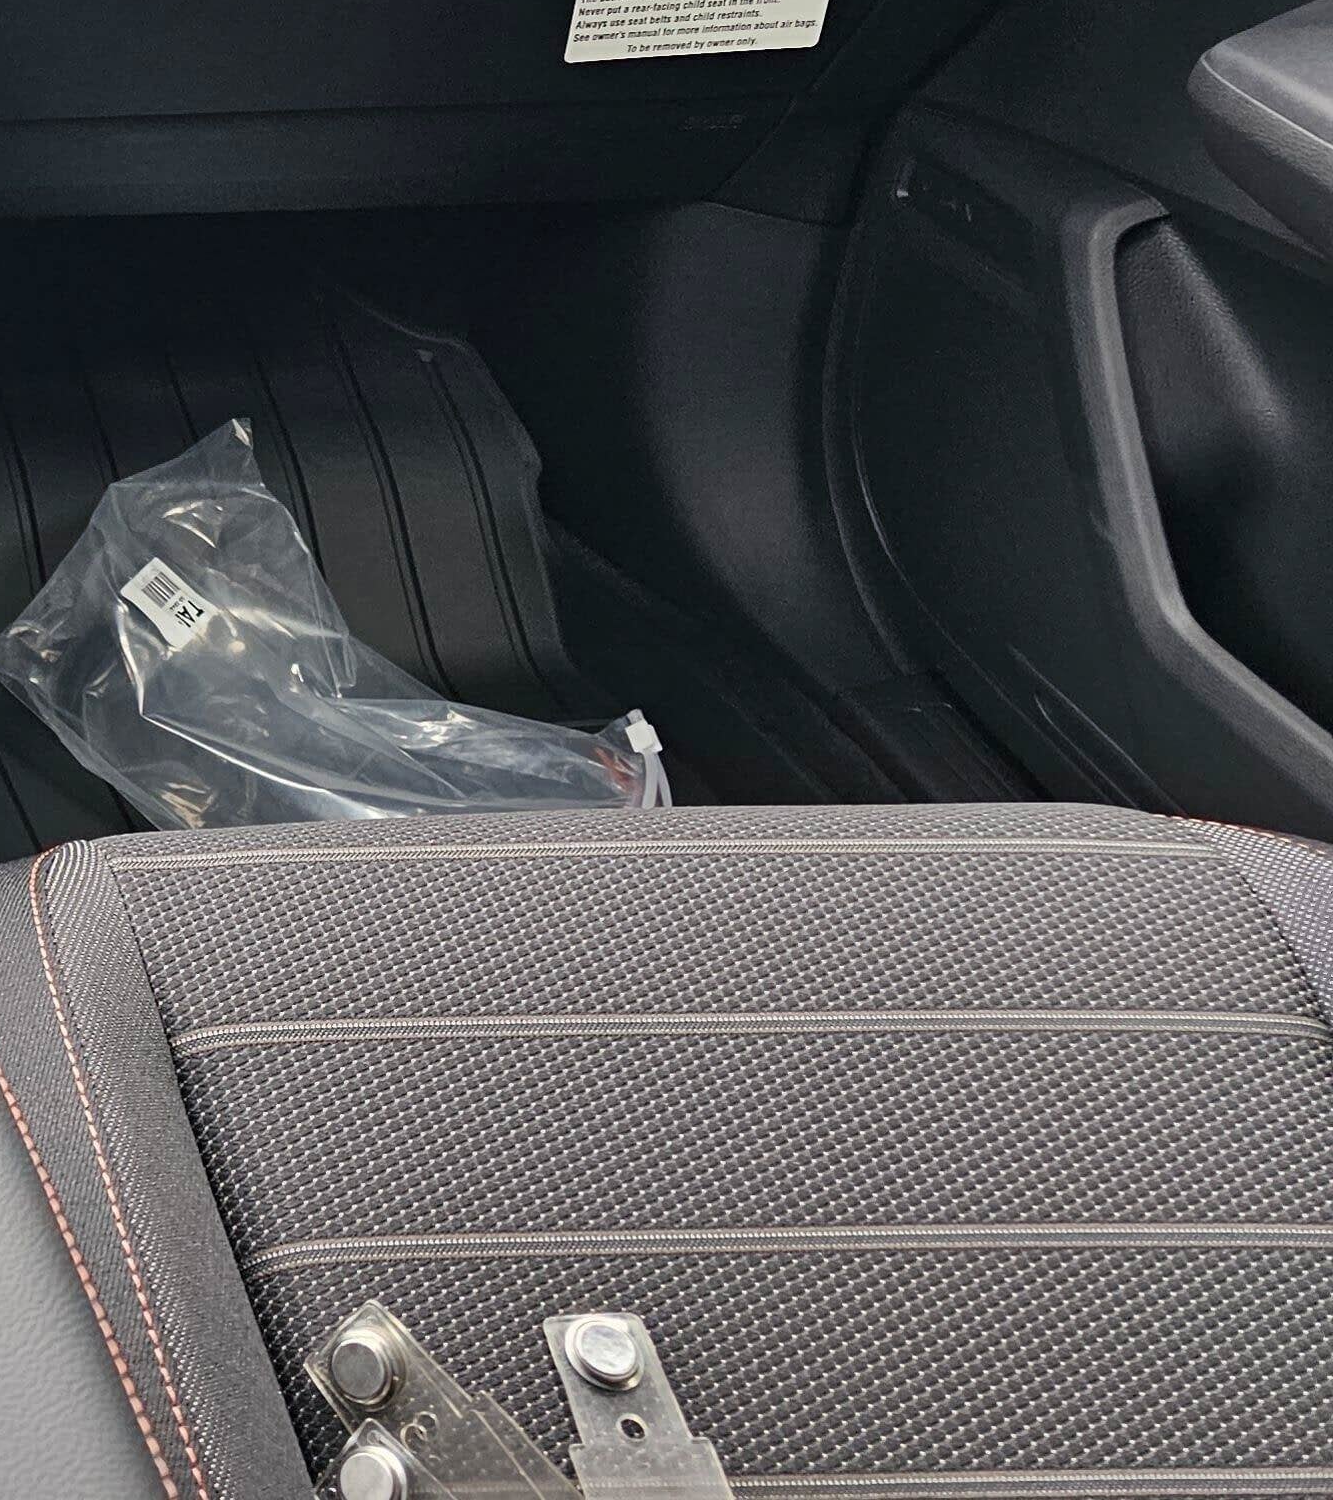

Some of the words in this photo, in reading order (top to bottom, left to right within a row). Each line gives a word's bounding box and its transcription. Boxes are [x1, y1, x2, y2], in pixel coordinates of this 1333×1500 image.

[578, 7, 607, 17] Never
[607, 6, 621, 16] put
[632, 2, 681, 13] rear-facing
[683, 0, 705, 9] child
[707, 0, 727, 8] seat
[575, 20, 607, 30] Always
[610, 19, 625, 27] use
[628, 17, 648, 26] seat
[650, 15, 671, 25] belts
[674, 13, 691, 22] and
[693, 11, 716, 21] child
[573, 33, 590, 42] See
[593, 31, 626, 41] owner's
[627, 29, 661, 39] manual
[663, 28, 675, 37] for
[677, 27, 700, 35] more
[702, 23, 751, 33] information
[753, 21, 779, 30] about
[781, 20, 793, 29] air
[627, 44, 636, 53] To
[639, 43, 651, 52] be
[652, 41, 692, 51] removed
[694, 40, 704, 49] by
[707, 39, 734, 47] owner
